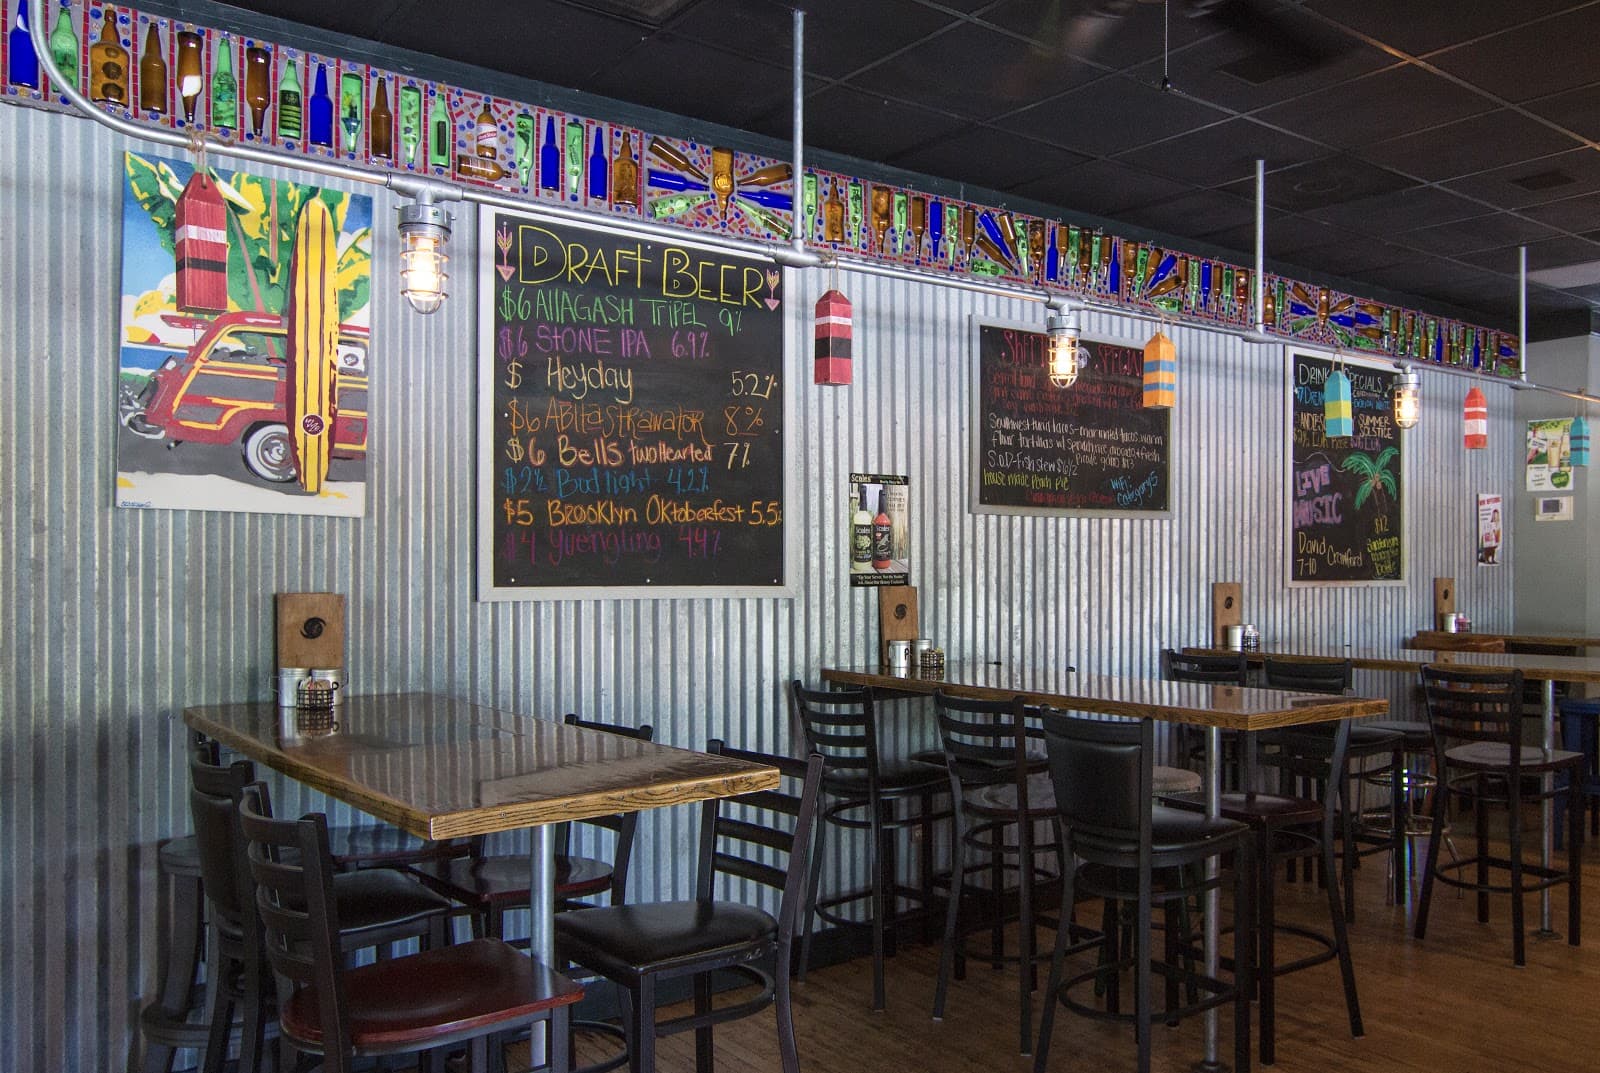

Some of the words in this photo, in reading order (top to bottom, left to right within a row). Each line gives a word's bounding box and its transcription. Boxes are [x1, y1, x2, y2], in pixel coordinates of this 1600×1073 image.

[662, 248, 763, 309] BEER
[499, 285, 531, 322] $6
[498, 325, 528, 361] $6
[621, 328, 651, 358] IPA
[503, 358, 523, 389] $
[547, 355, 634, 404] Heyday
[508, 397, 541, 436] $6
[724, 406, 764, 436] 8%
[506, 436, 546, 466] $6
[557, 433, 626, 468] Bells
[556, 468, 601, 499] Bud
[1296, 464, 1331, 497] LIVE
[503, 497, 534, 526] $5
[1293, 492, 1343, 529] MUSIC
[1298, 531, 1327, 556] David
